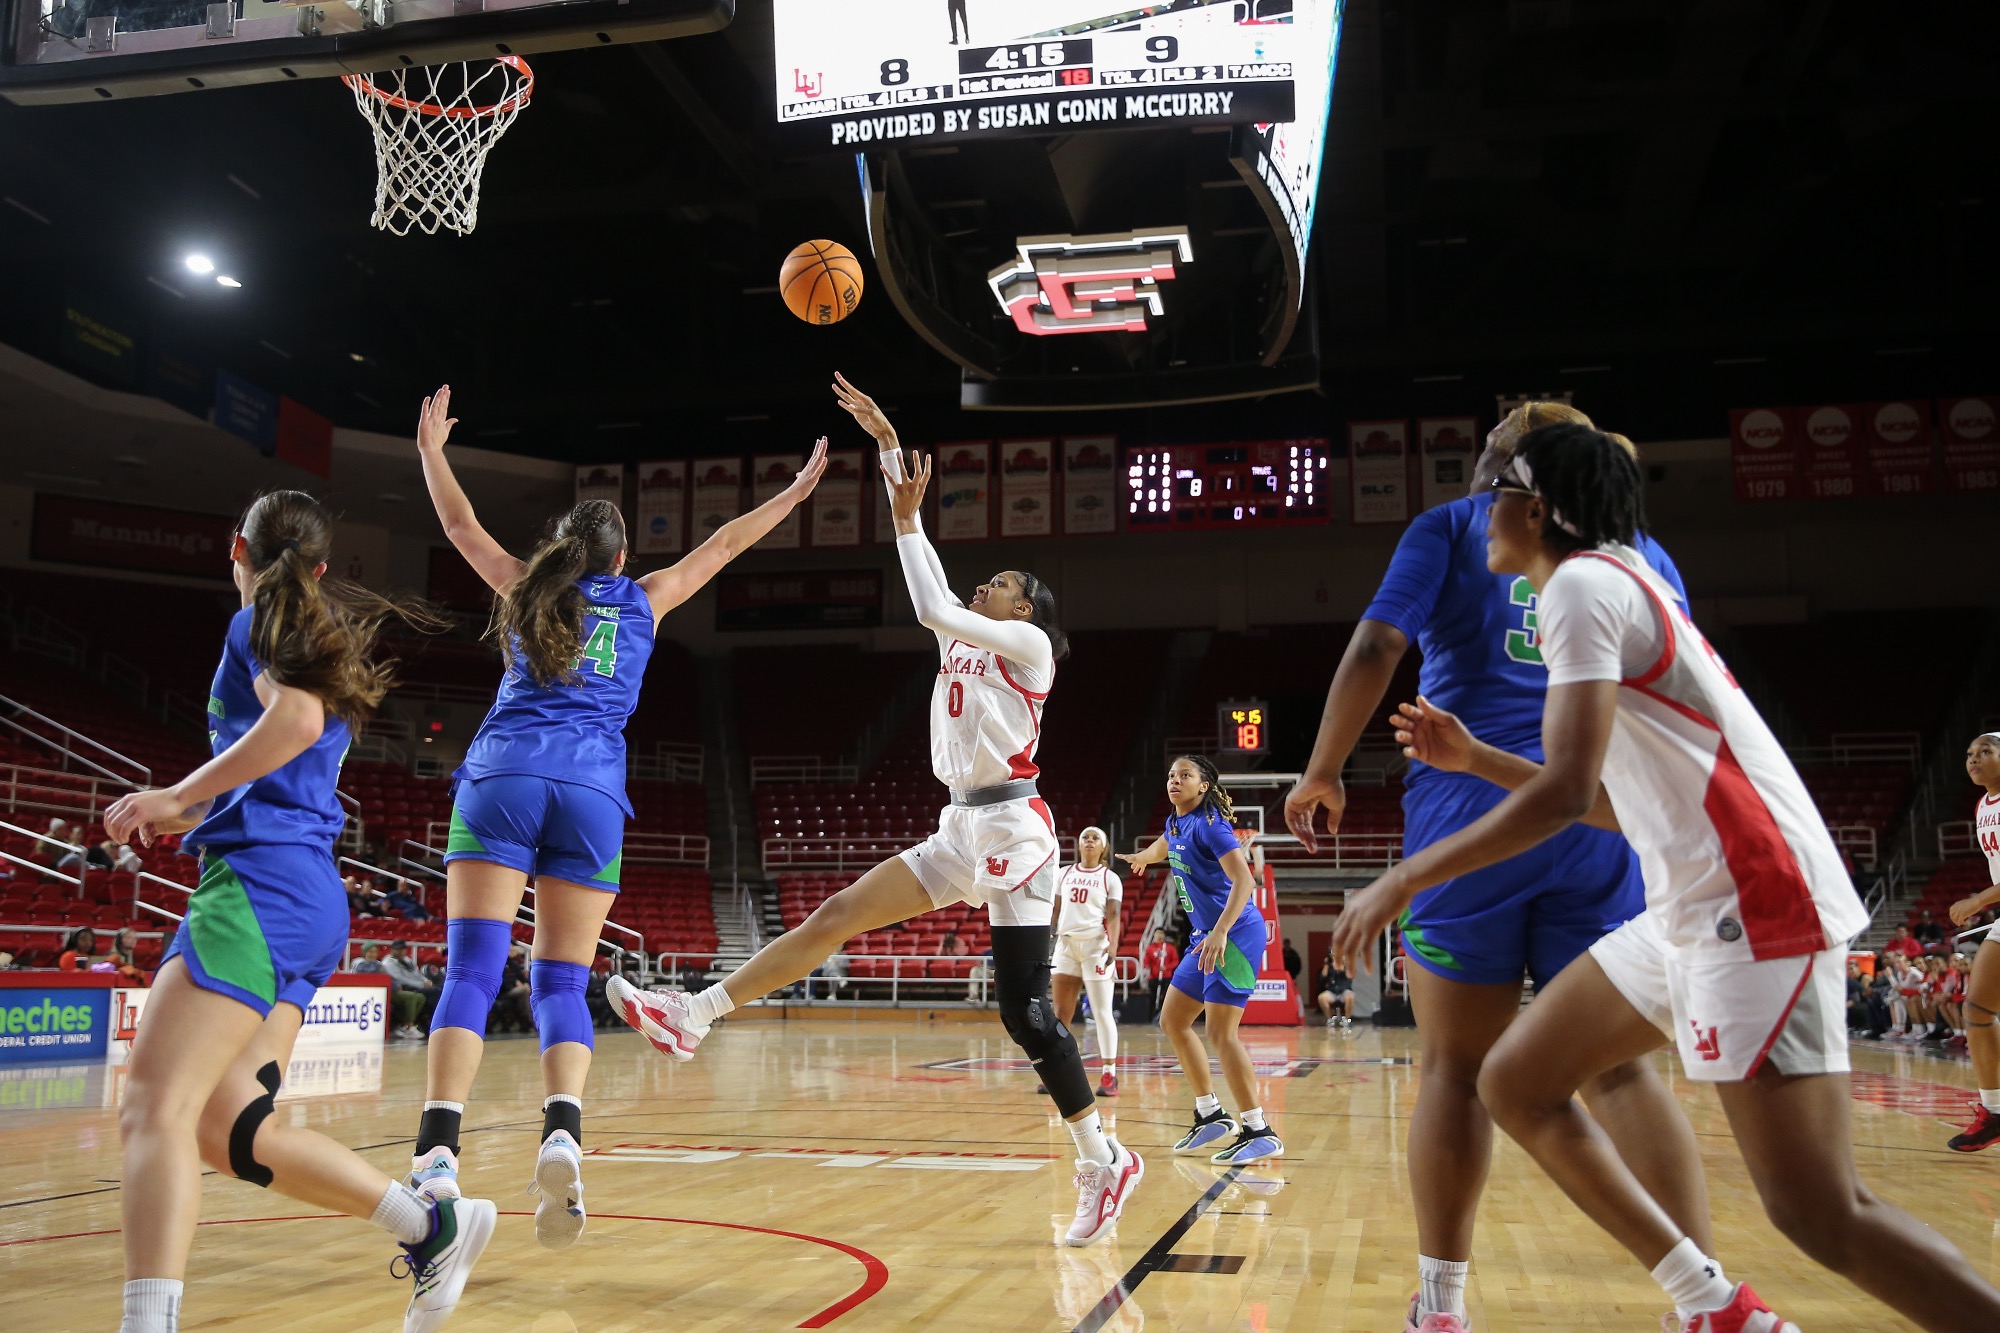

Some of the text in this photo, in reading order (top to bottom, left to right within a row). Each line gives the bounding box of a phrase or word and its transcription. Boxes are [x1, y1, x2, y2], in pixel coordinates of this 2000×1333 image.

[985, 43, 1065, 70] 4:15
[1146, 36, 1178, 63] 9
[881, 59, 909, 86] 8
[991, 73, 1052, 91] Period
[1061, 68, 1090, 86] 18
[1102, 70, 1155, 84] TOL 4
[1202, 66, 1217, 80] 2
[875, 92, 891, 105] 4
[935, 86, 944, 99] 1
[784, 99, 836, 118] LAMAR
[831, 91, 1233, 145] PROVIDED BY SUSAN CONN MCCURRY
[1190, 478, 1202, 496] 8
[1746, 479, 1786, 498] 1979
[569, 620, 618, 678] 4
[939, 656, 986, 676] AMAR
[948, 681, 963, 717] 0
[1238, 724, 1258, 750] 18
[1981, 831, 1999, 857] 44
[1066, 877, 1100, 888] LAMAR
[1070, 888, 1088, 904] 30
[304, 996, 383, 1030] nning's
[29, 1034, 61, 1046] CREDIT
[63, 1033, 91, 1045] UNION
